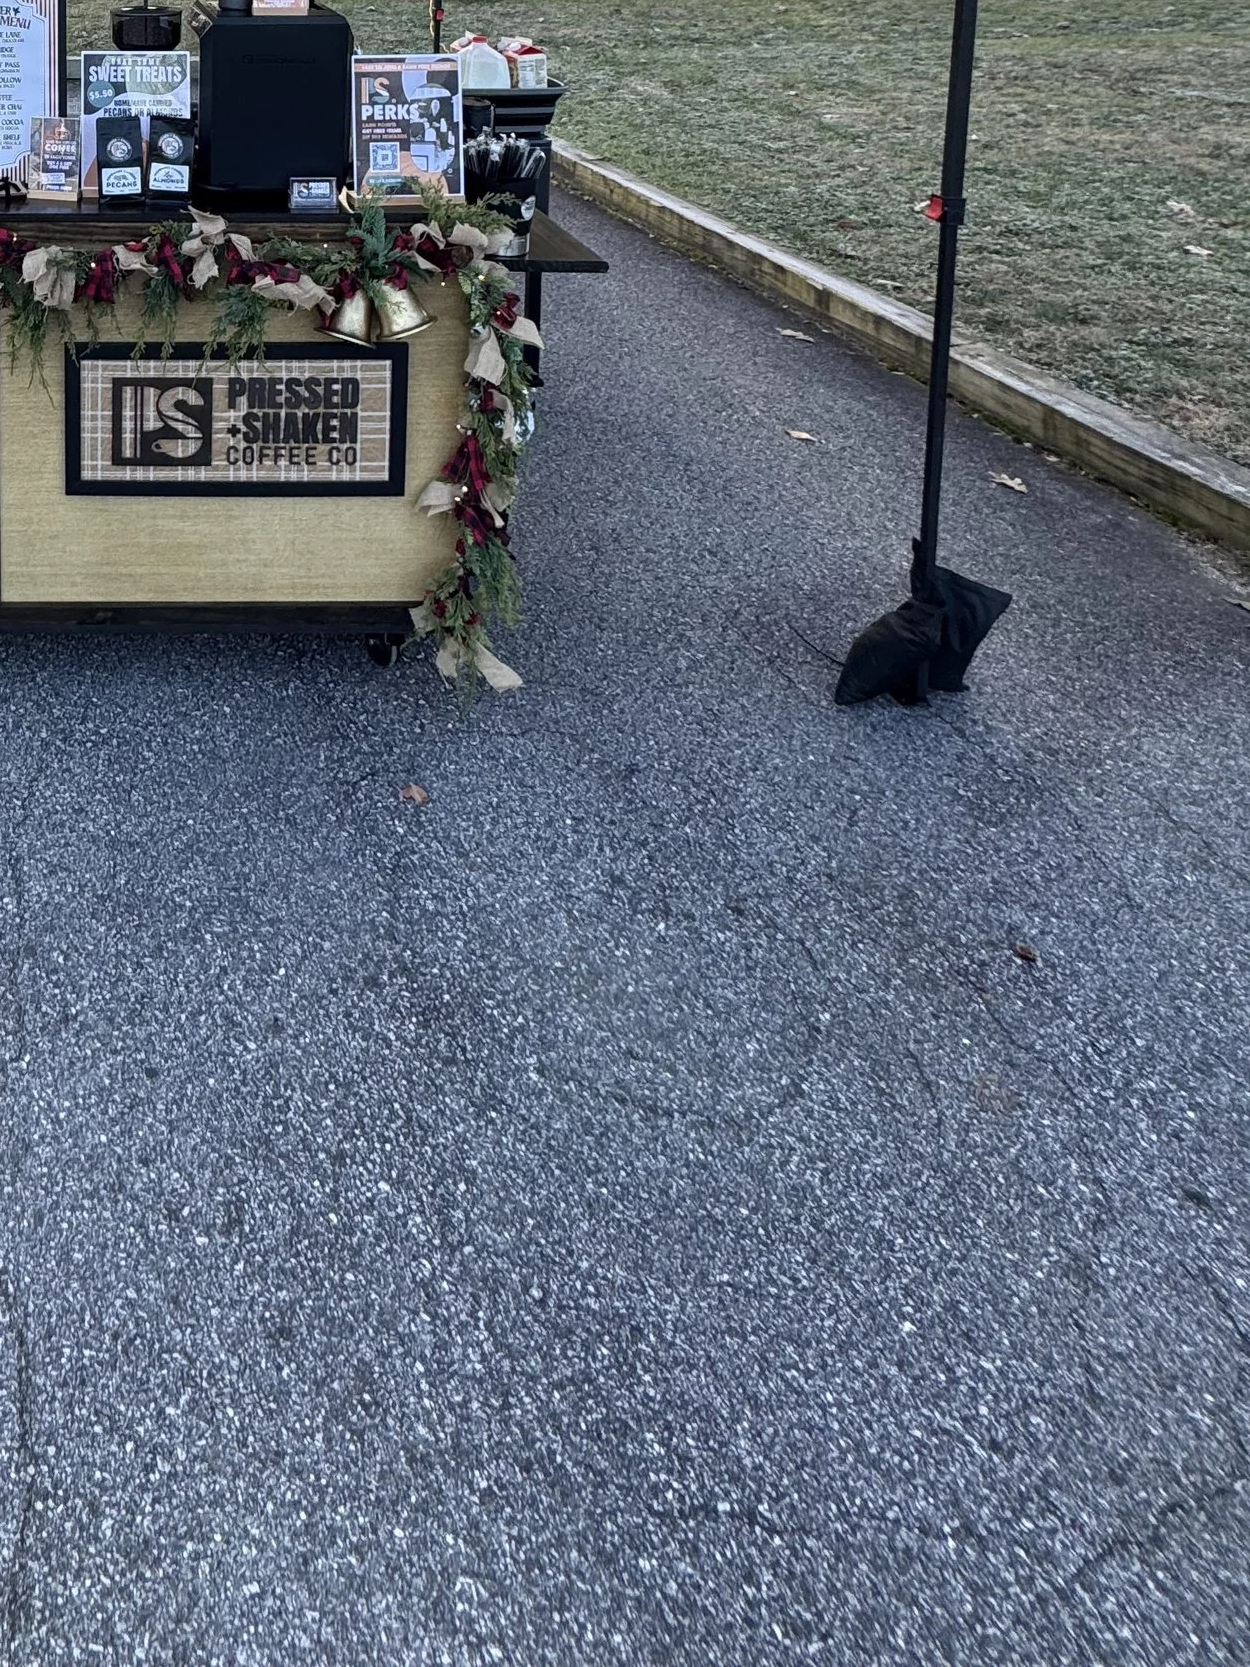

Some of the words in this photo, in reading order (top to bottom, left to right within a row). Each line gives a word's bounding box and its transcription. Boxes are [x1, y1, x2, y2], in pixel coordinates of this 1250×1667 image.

[0, 16, 31, 30] MENU
[89, 65, 131, 82] SWEET
[135, 66, 182, 83] TREATS
[89, 88, 112, 101] $5.50
[361, 103, 420, 121] PERKS
[106, 181, 137, 189] PECANS
[227, 377, 360, 410] PRESSED
[226, 445, 318, 466] COFFEE
[328, 445, 357, 466] CO
